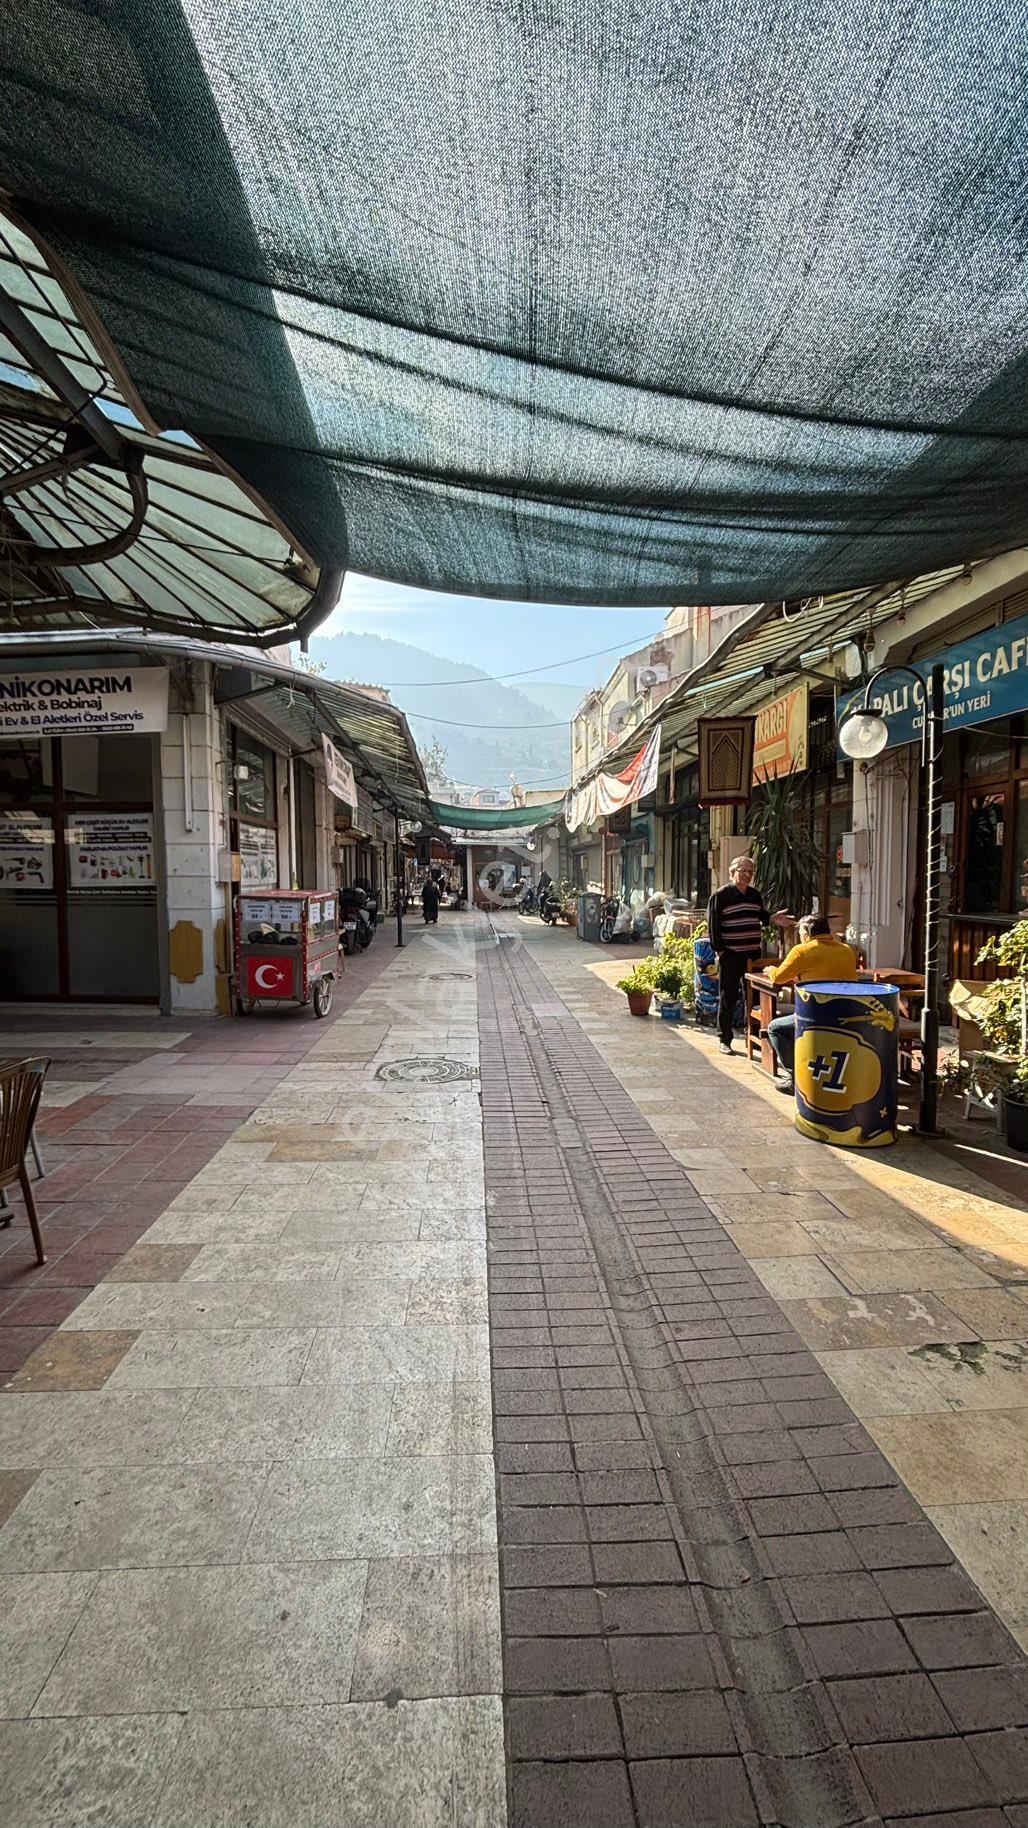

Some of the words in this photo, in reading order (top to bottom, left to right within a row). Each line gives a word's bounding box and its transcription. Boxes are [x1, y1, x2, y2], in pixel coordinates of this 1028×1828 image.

[0, 676, 132, 698] NİKONARIM
[849, 685, 909, 718] PALI
[976, 637, 1028, 682] CAF
[38, 700, 48, 710] &
[51, 696, 102, 711] Bobinaj
[967, 691, 992, 712] YERİ
[5, 717, 18, 726] Ev
[20, 716, 29, 725] &
[31, 715, 41, 725] El
[43, 712, 82, 724] Aletleri
[84, 711, 109, 723] Özel
[110, 710, 144, 721] Servis
[807, 1051, 850, 1094] +1
